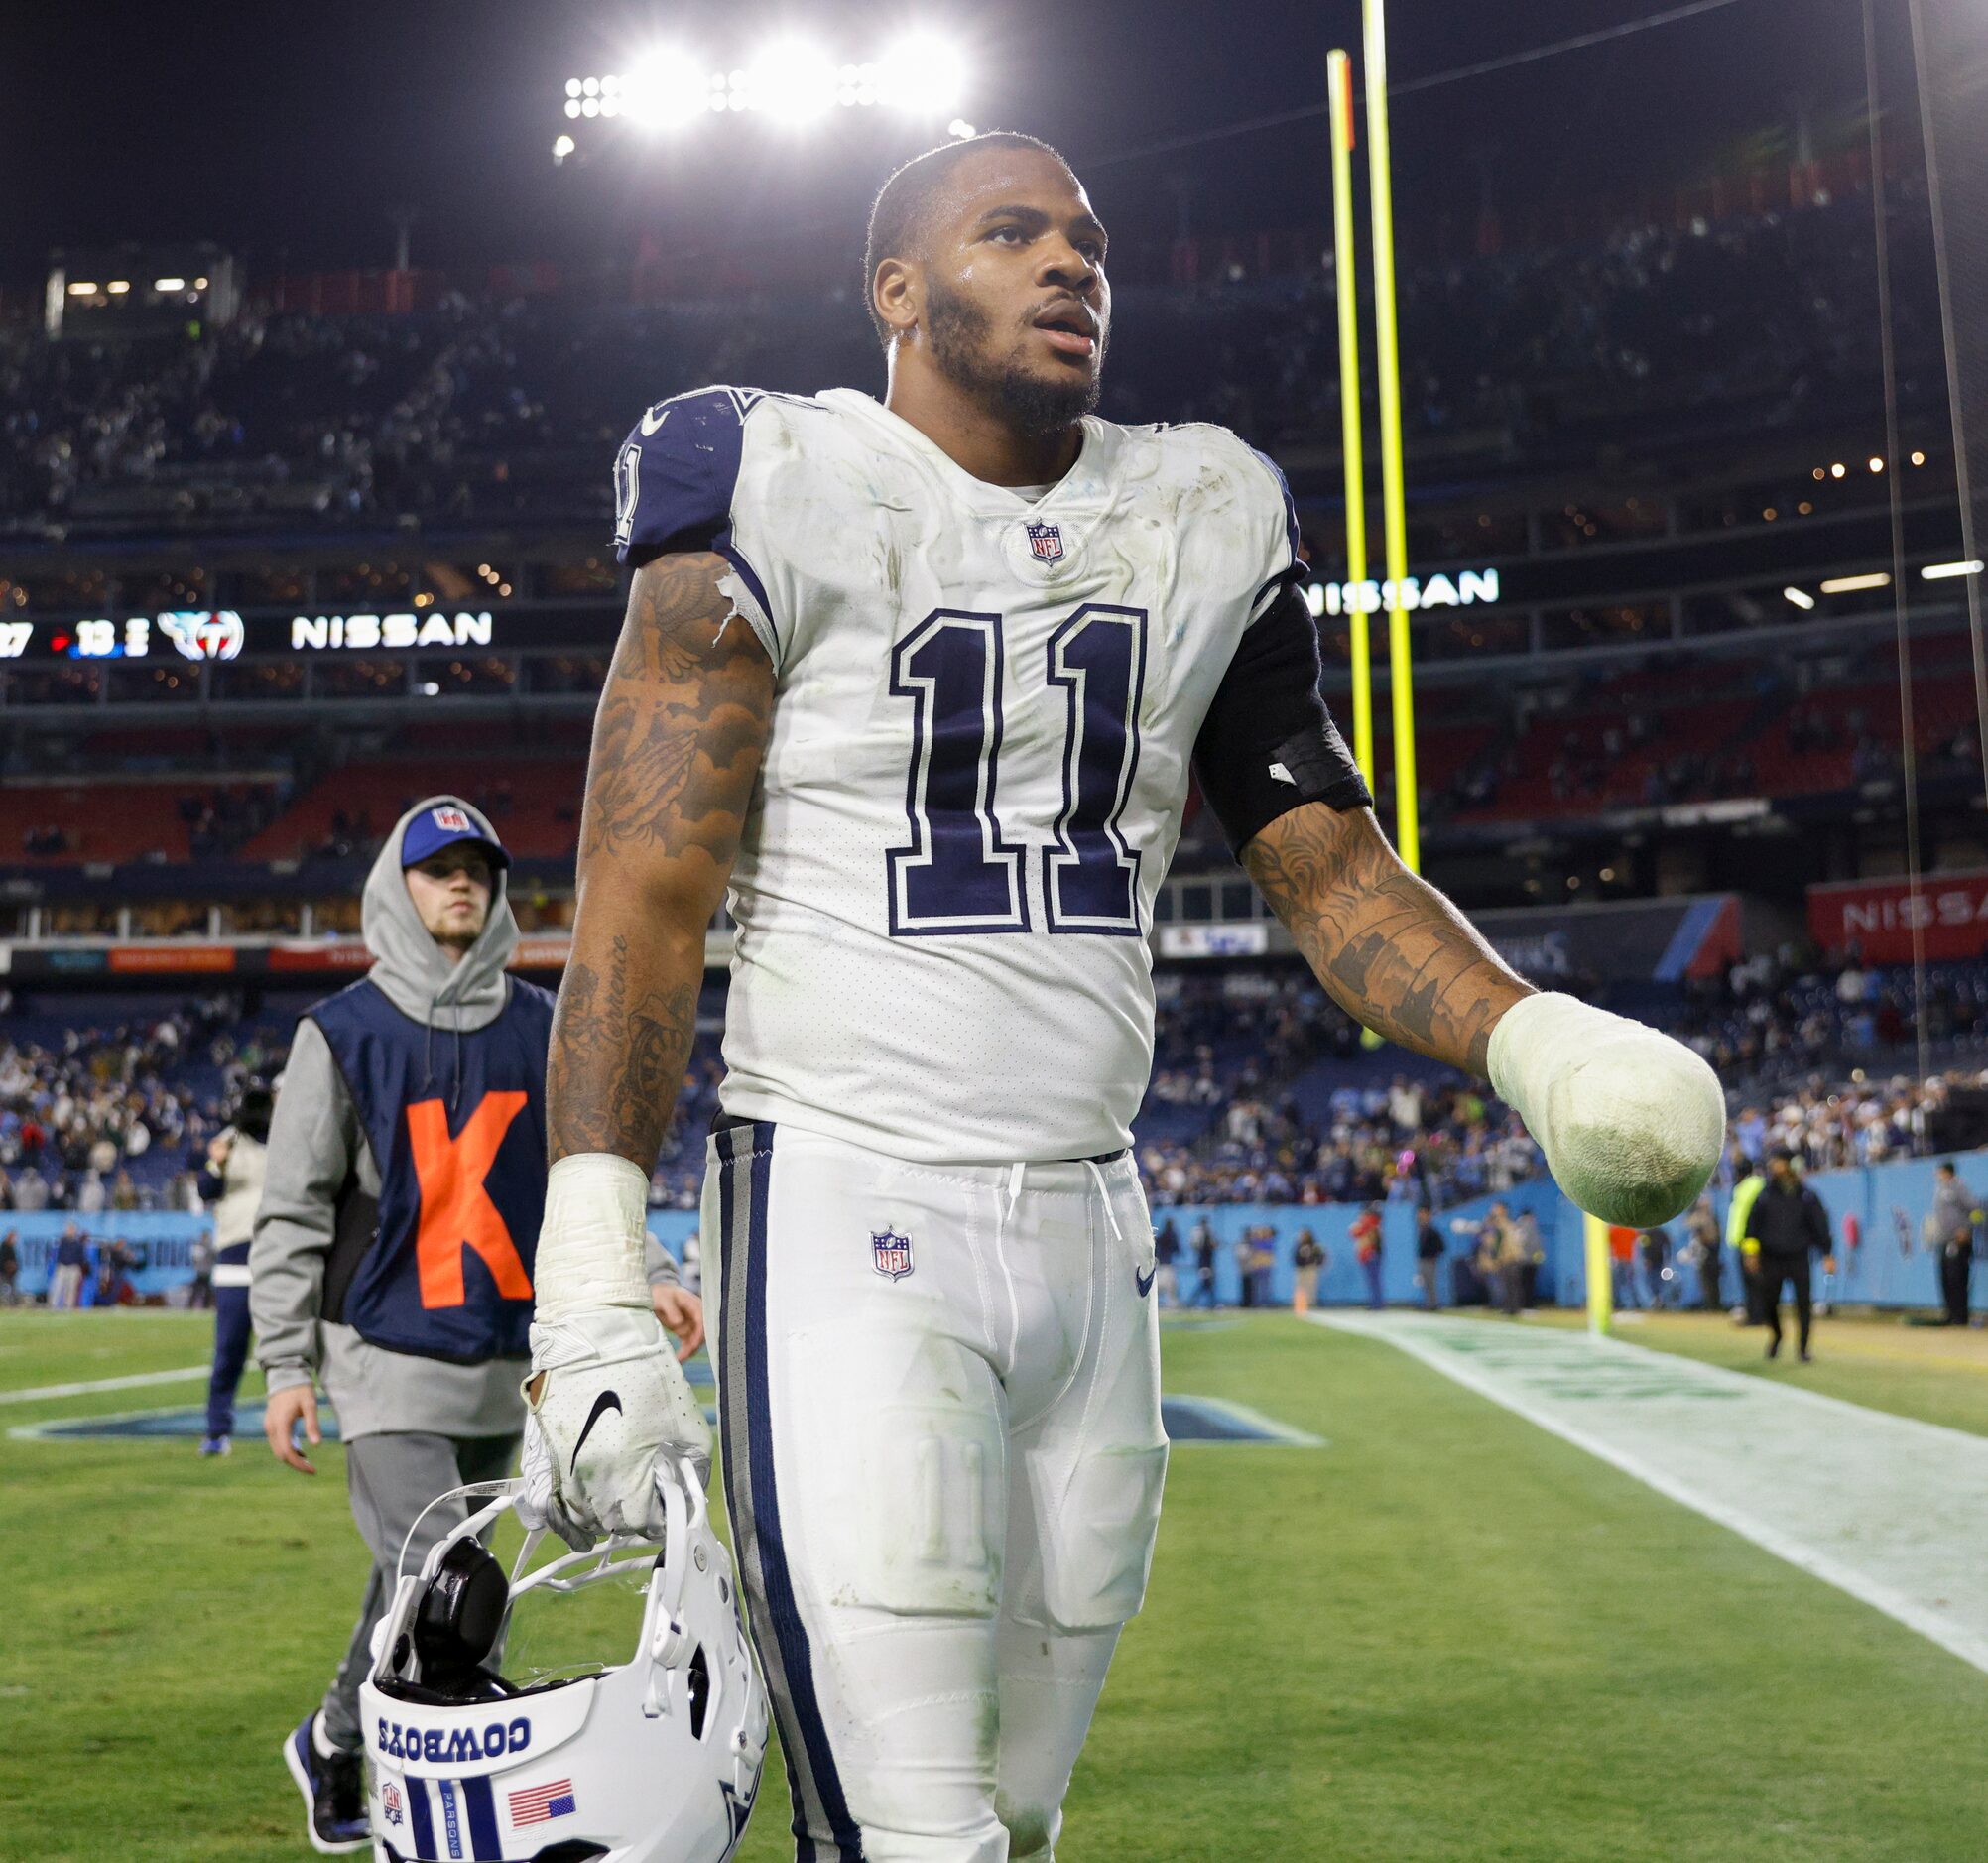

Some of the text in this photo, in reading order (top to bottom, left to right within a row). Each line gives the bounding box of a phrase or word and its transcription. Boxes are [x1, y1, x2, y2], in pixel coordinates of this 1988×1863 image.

[1034, 539, 1061, 557] NFL
[292, 611, 492, 650] NISSAN
[886, 603, 1147, 936] 11
[1842, 891, 1988, 932] NISS
[406, 1090, 534, 1310] K
[879, 1250, 908, 1271] NFL
[378, 1715, 532, 1763] COWBOYS
[383, 1785, 401, 1810] NFL
[443, 1792, 461, 1858] PARSONS
